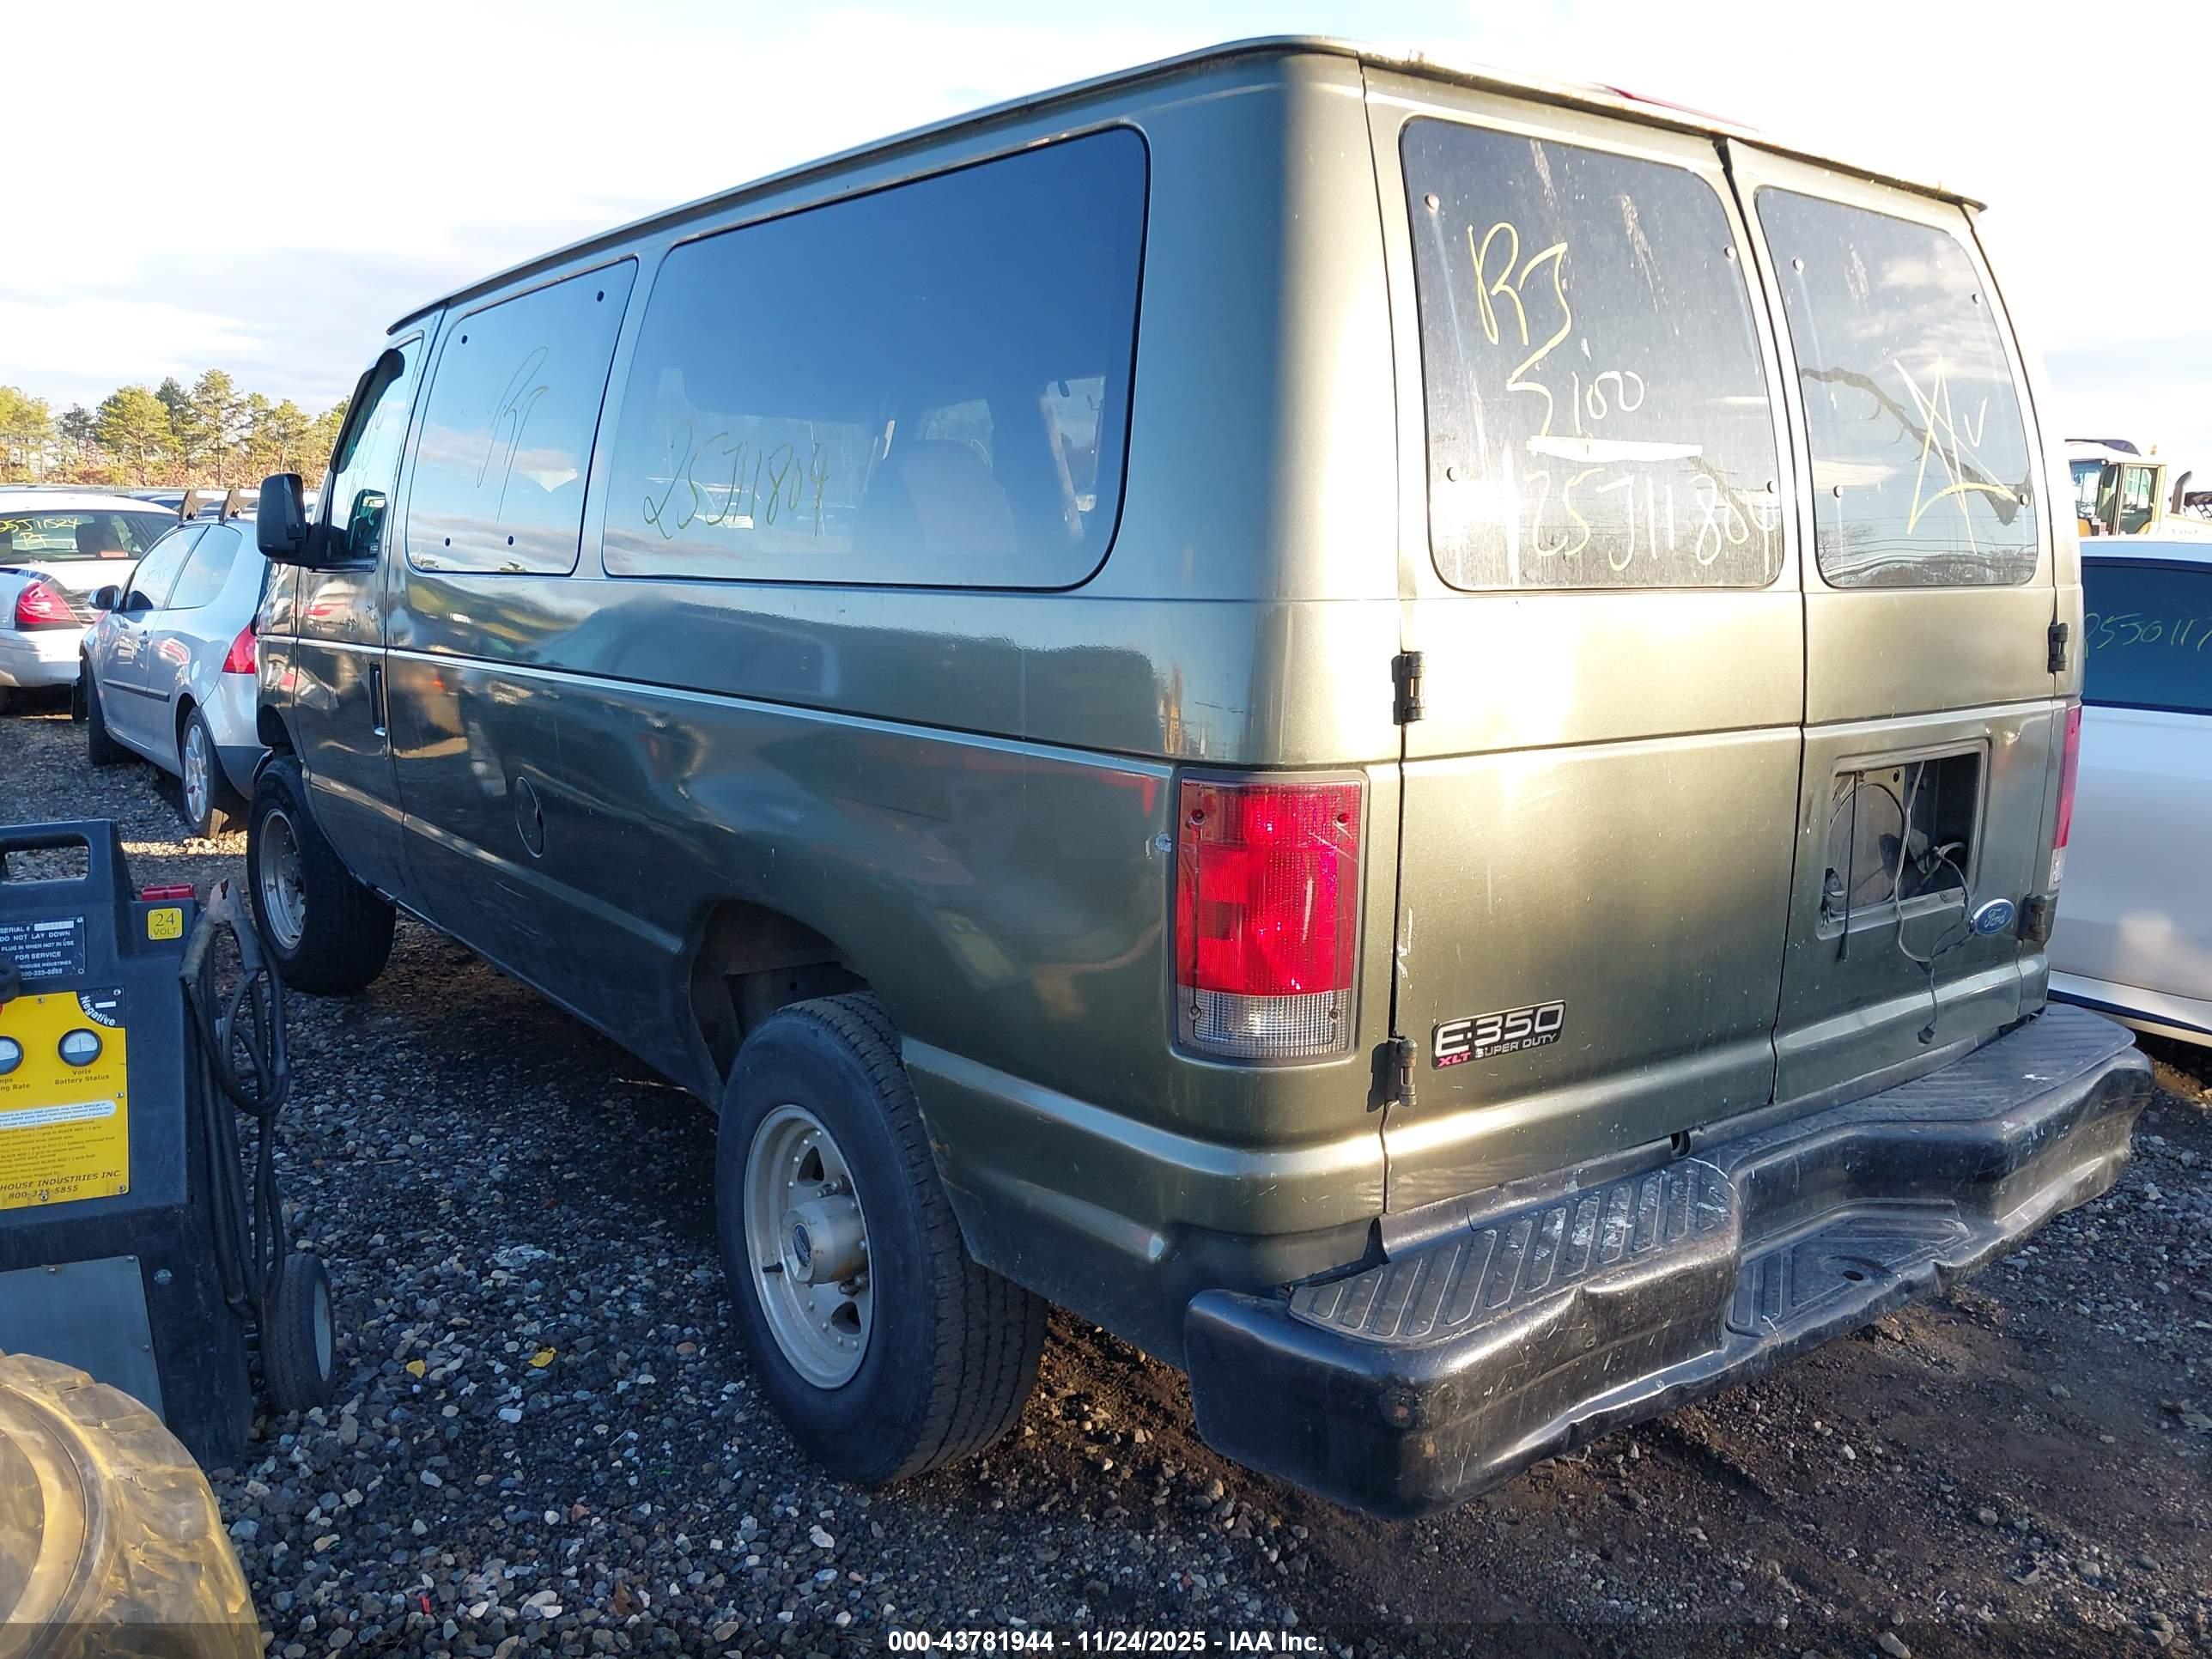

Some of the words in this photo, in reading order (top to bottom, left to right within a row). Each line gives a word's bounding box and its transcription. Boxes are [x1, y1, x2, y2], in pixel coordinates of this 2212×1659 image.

[155, 913, 175, 927] 24
[1984, 907, 2008, 928] Ford
[81, 995, 115, 1026] Negative
[1438, 1050, 1471, 1066] XLT
[1475, 1041, 1519, 1058] SUPER
[1522, 1033, 1557, 1048] DUTY
[38, 1173, 98, 1187] INDUSTRIES
[101, 1170, 122, 1179] INC.
